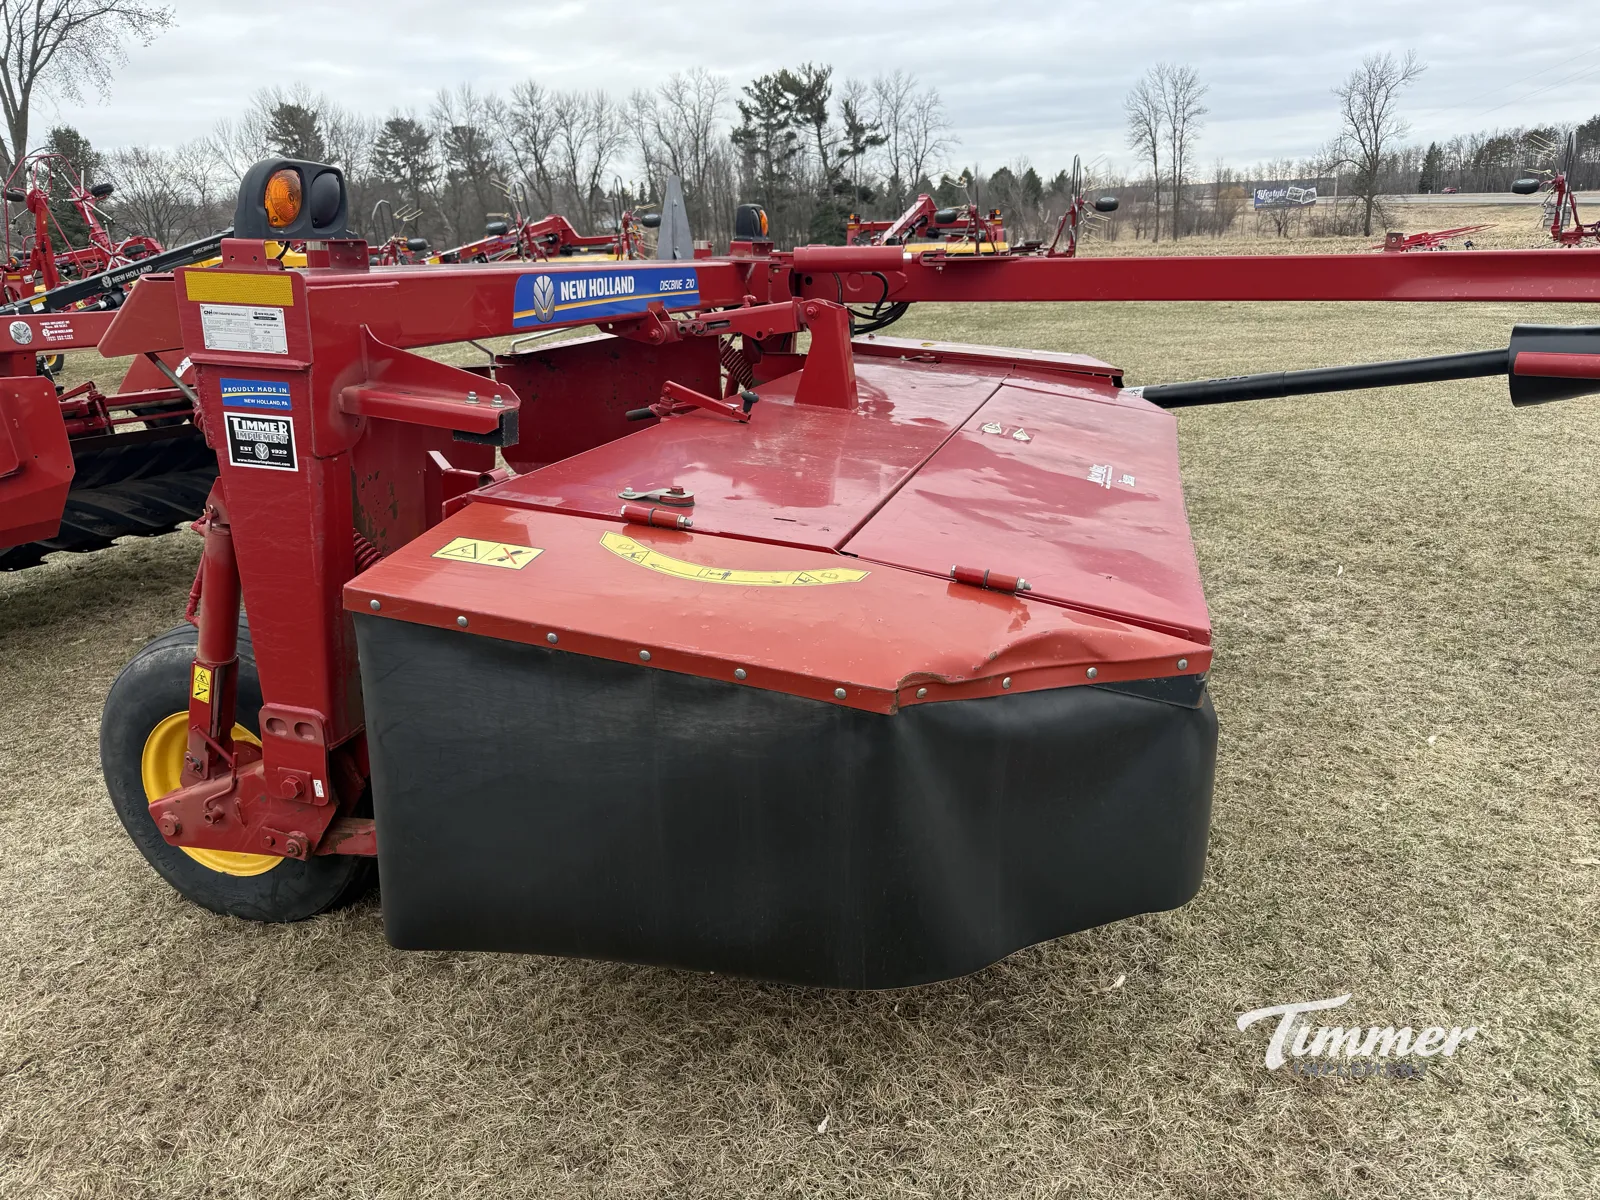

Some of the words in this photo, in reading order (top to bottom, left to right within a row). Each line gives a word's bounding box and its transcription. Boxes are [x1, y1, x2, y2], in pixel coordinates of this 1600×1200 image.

[1257, 189, 1287, 200] Lifestyle
[112, 273, 126, 284] NEW
[126, 265, 153, 280] HOLLAND
[560, 280, 587, 301] NEW
[589, 276, 635, 297] HOLLAND
[660, 279, 683, 291] DISCBINE
[685, 278, 695, 289] 210
[229, 417, 289, 435] TIMMER
[235, 430, 289, 444] IMPLEMENT
